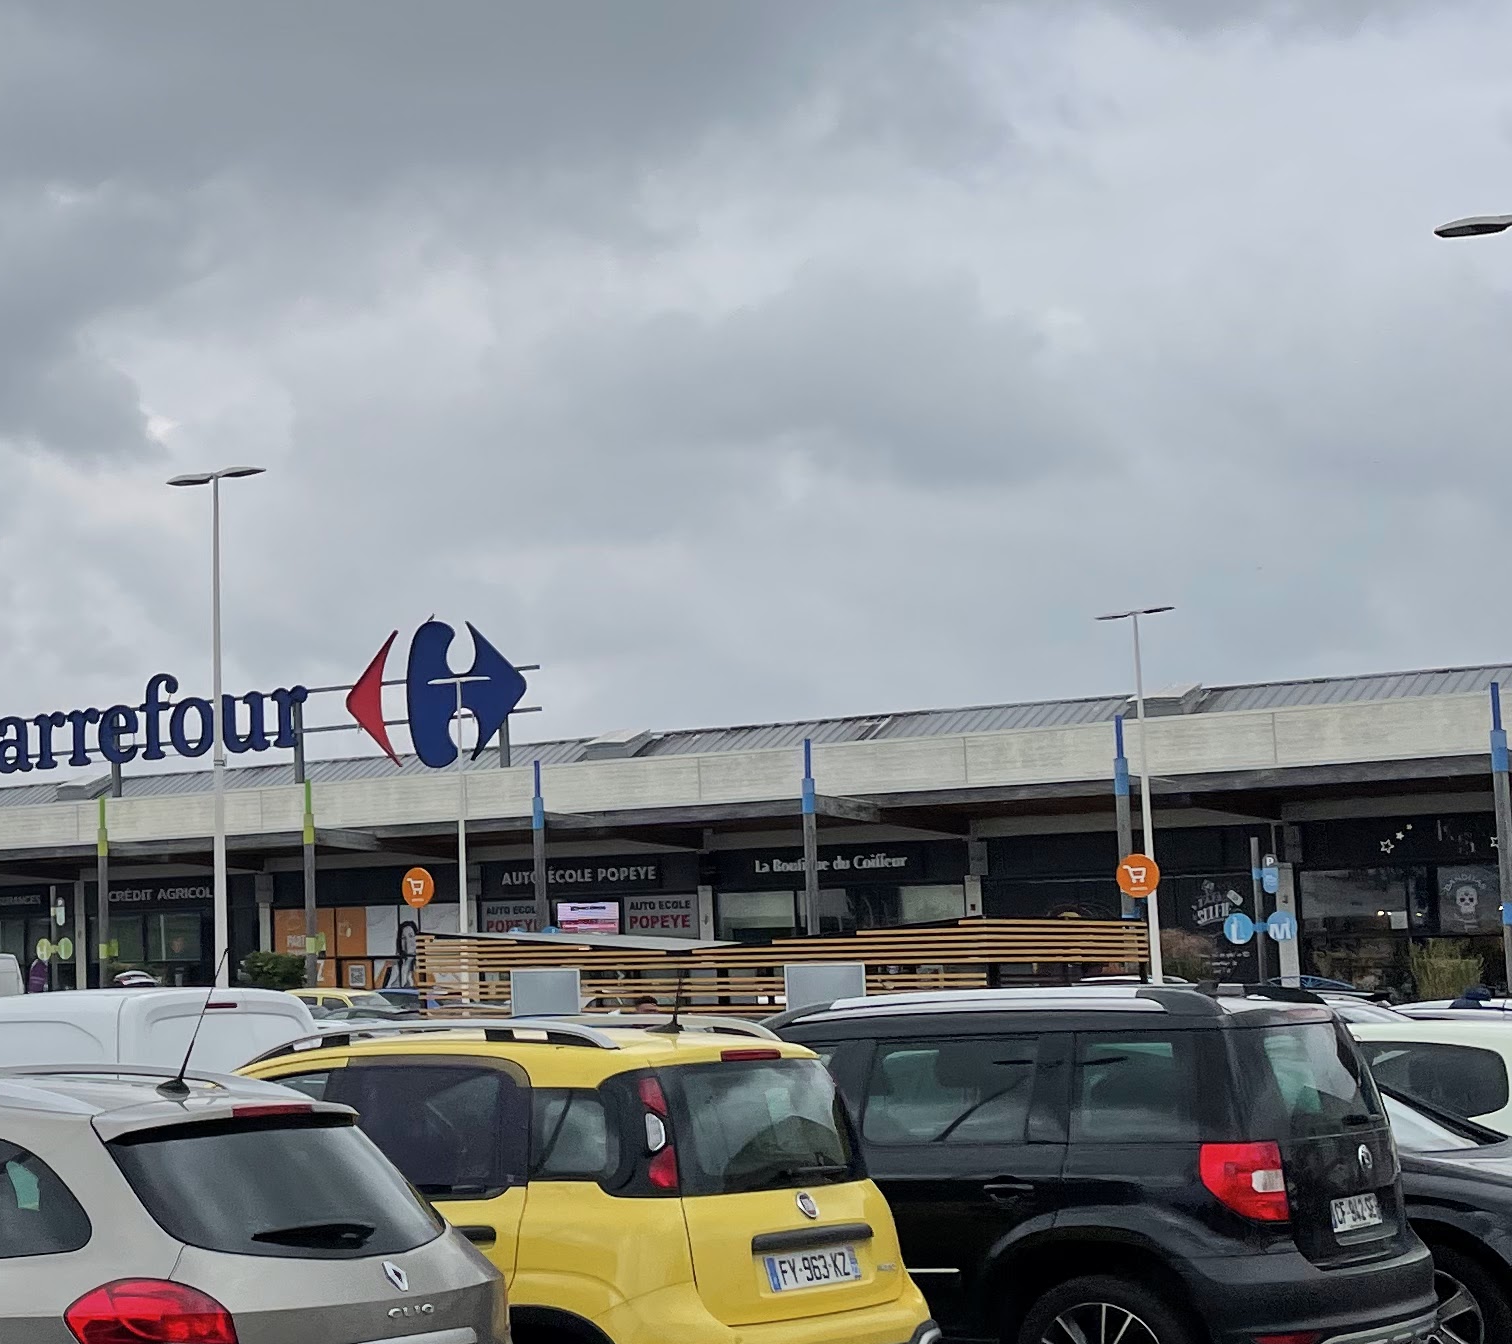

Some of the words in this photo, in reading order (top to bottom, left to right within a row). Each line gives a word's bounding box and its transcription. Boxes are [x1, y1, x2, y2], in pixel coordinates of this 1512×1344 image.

[832, 856, 850, 870] du
[853, 853, 908, 869] Coiffeur
[548, 866, 592, 884] ÉCOLE
[597, 865, 657, 882] POPEYE
[108, 887, 153, 903] CRÉDIT
[157, 886, 214, 900] AGRICOL
[487, 905, 511, 916] AUTO
[513, 904, 536, 915] ECOL
[629, 900, 656, 911] AUTO
[629, 913, 691, 930] POPEYE
[778, 1252, 851, 1285] FY-963-KZ
